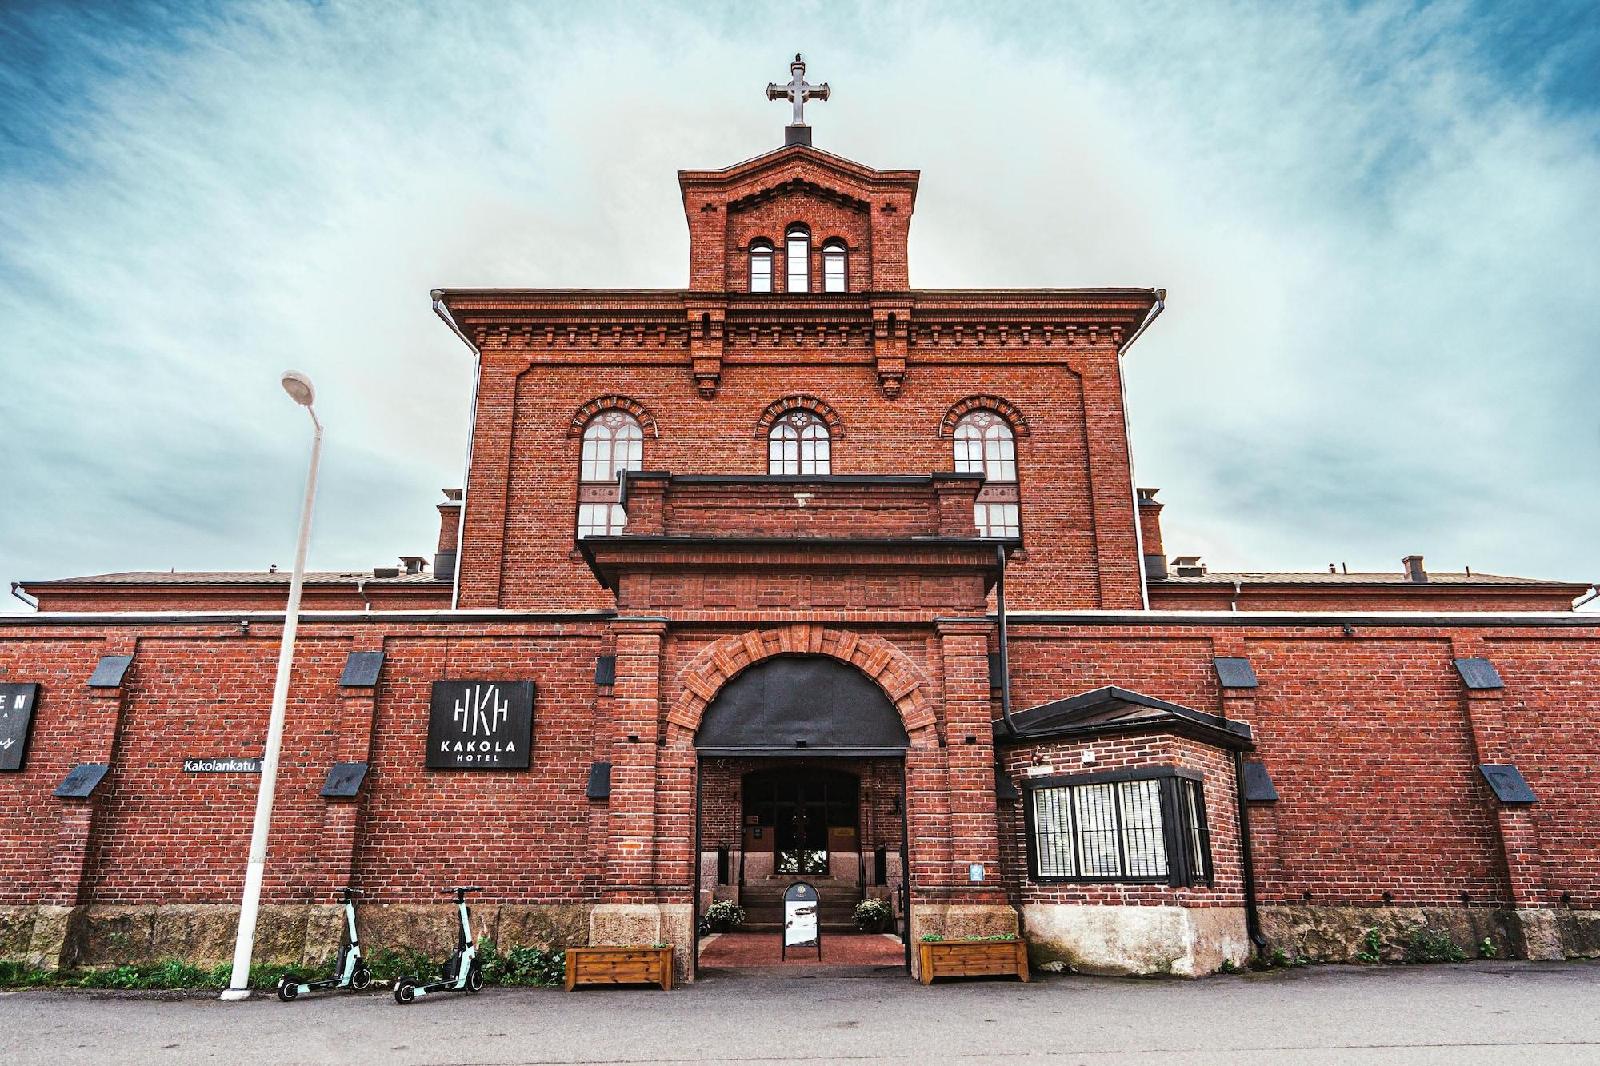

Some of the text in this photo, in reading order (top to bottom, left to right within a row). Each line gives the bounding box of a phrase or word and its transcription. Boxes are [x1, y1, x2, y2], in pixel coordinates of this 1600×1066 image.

[454, 685, 508, 736] HKH
[441, 741, 515, 752] KAKOLA
[184, 760, 255, 771] Kakolankatu
